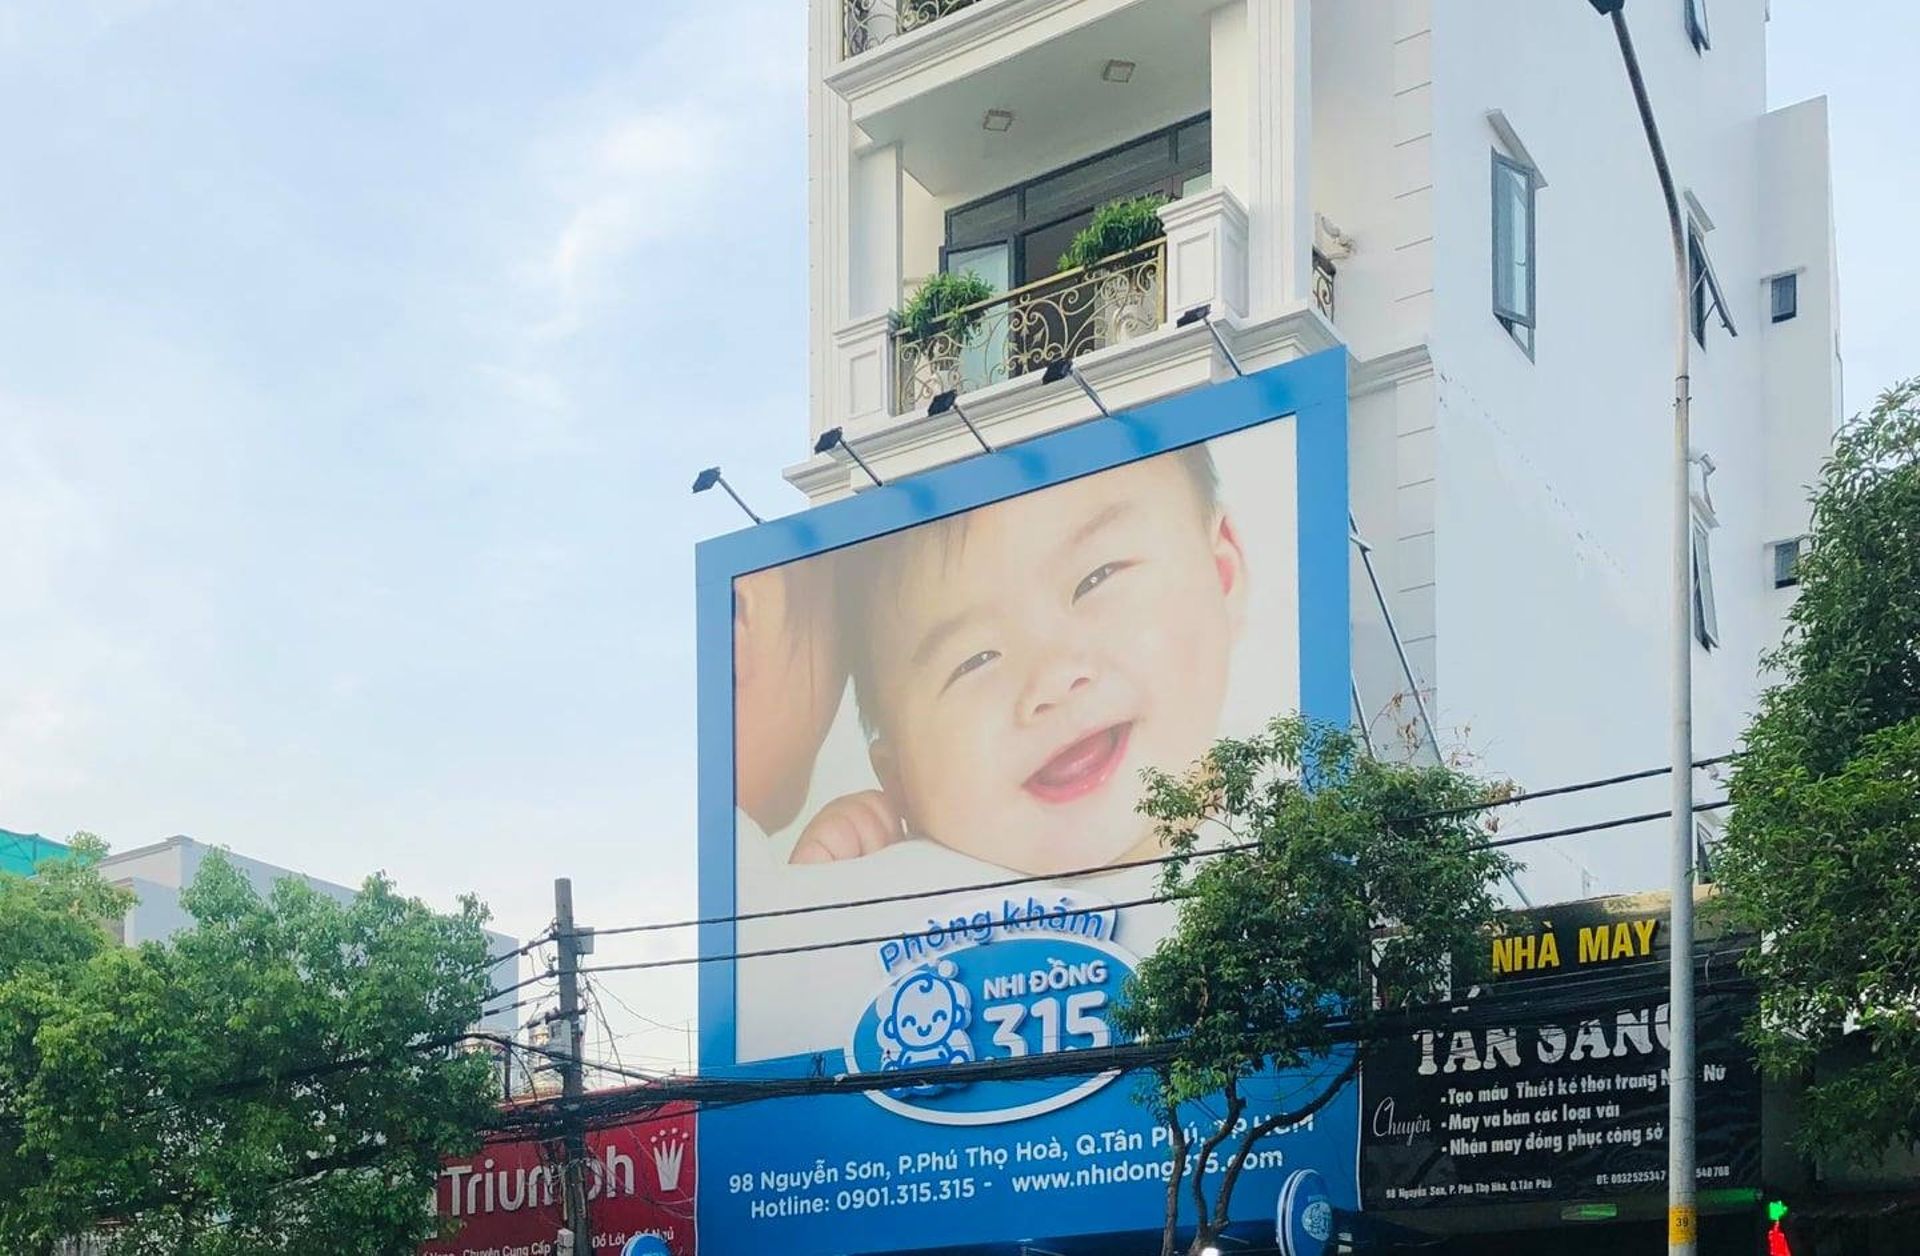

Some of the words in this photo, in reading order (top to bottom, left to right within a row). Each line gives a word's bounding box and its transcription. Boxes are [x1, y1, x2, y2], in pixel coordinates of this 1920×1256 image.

[880, 911, 993, 972] Phòng
[1002, 897, 1104, 939] khám
[1492, 921, 1560, 972] NHÀ
[1579, 919, 1657, 963] MAY
[983, 973, 1026, 999] NHI
[1028, 957, 1107, 993] ĐỒNG
[983, 990, 1111, 1060] 315
[1615, 1072, 1657, 1092] trang
[1373, 1096, 1431, 1146] Chuyên
[1448, 1113, 1479, 1133] May
[1491, 1138, 1522, 1155] may
[1567, 1128, 1602, 1152] phục
[1606, 1126, 1641, 1147] công
[729, 1174, 754, 1194] 98
[760, 1159, 838, 1192] Nguyễn
[845, 1161, 891, 1181] Sơn,
[899, 1149, 958, 1175] P.Phú
[965, 1145, 1008, 1170] Thọ
[1016, 1136, 1068, 1162] Hoà,
[1076, 1128, 1142, 1156] Q.Tân
[751, 1195, 830, 1219] Hotline:
[836, 1177, 975, 1211] 0901.315.315
